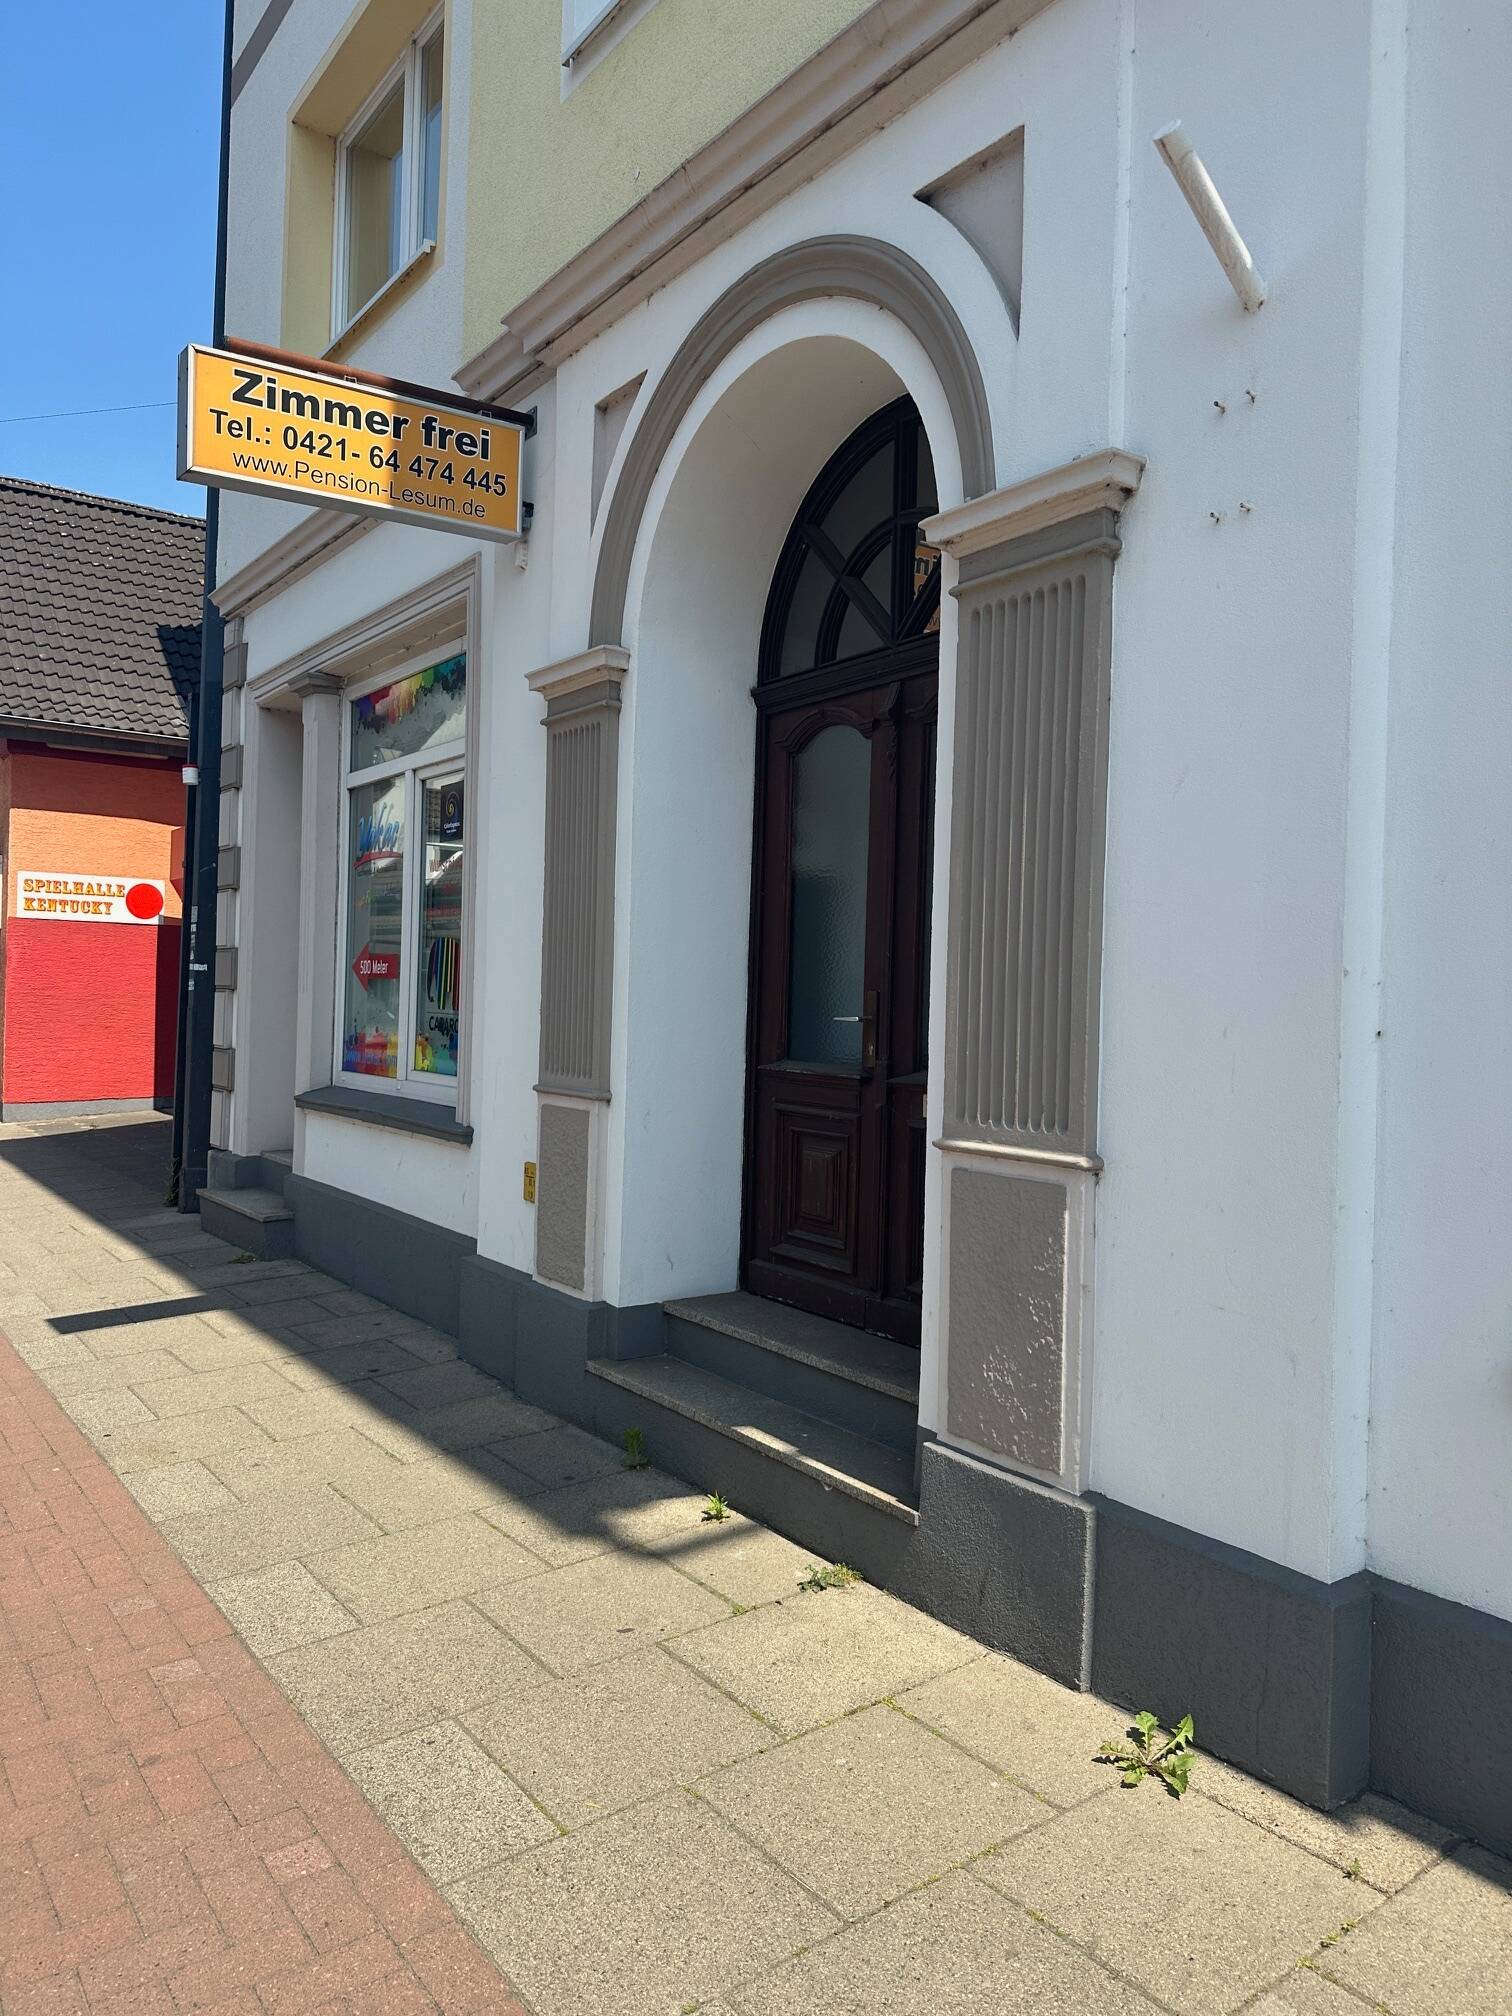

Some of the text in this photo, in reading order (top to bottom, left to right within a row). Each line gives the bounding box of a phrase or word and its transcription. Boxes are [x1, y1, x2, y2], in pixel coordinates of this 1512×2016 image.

[231, 369, 490, 461] Zimmer frei
[209, 408, 507, 498] Tel.: 0421- 64 474 445
[232, 452, 486, 519] www.Pension-Lesum.de
[23, 878, 126, 898] SPIELHALLE
[23, 896, 114, 915] KENTUCKY
[360, 959, 389, 975] 500 Meter
